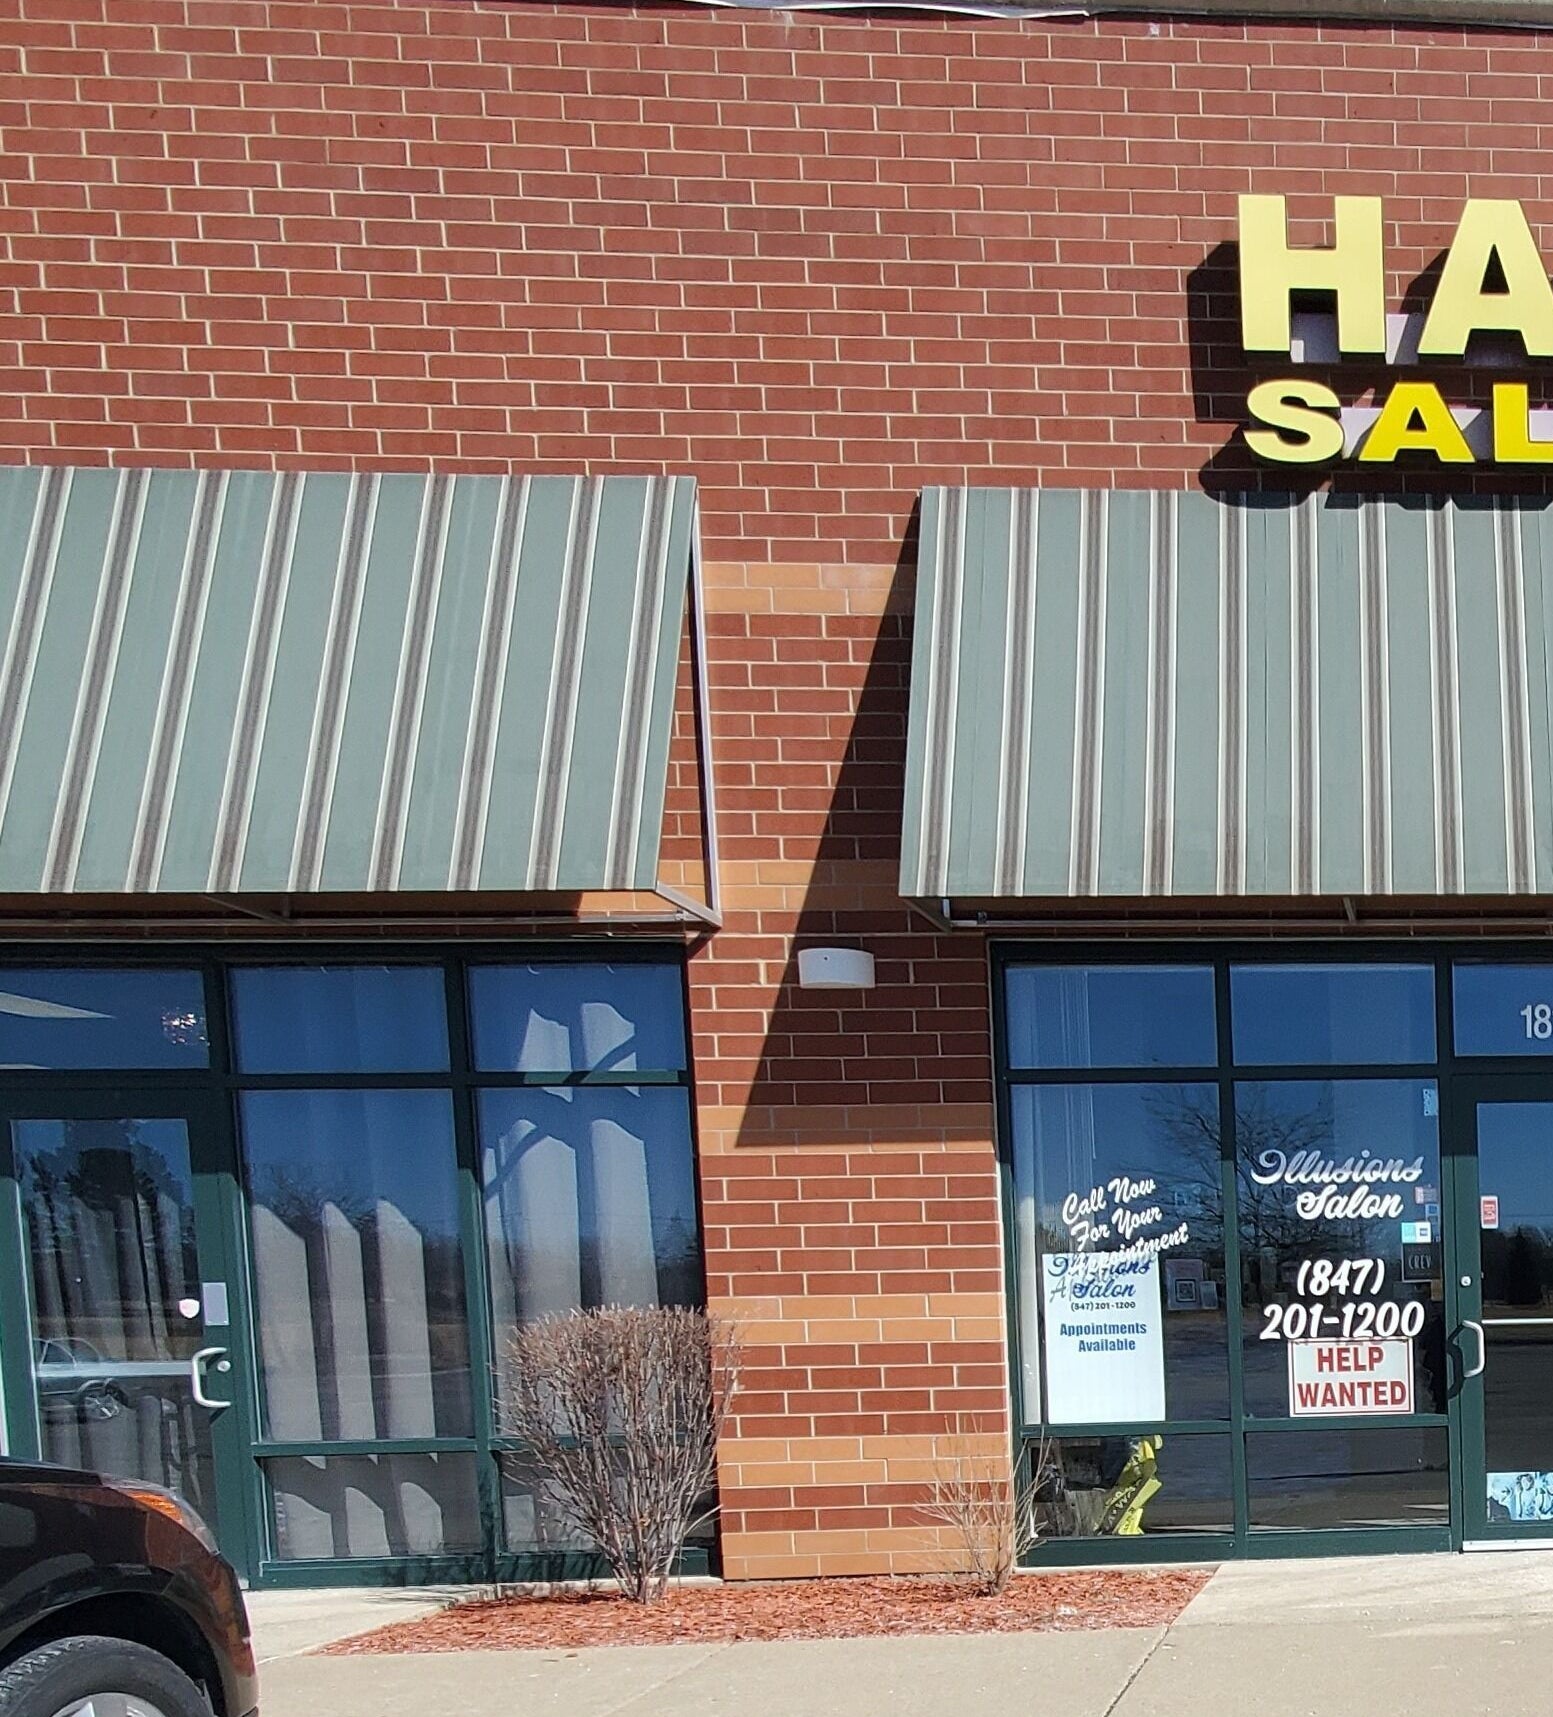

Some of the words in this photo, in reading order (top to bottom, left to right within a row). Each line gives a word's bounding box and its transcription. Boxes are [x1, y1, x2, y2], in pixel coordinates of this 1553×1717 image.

[1250, 1149, 1425, 1185] Illusions
[1062, 1186, 1107, 1225] Call
[1108, 1176, 1157, 1204] Now
[1296, 1185, 1404, 1220] Salon
[1071, 1221, 1111, 1252] For
[1111, 1206, 1163, 1240] Your
[1048, 1255, 1151, 1276] Iions
[1297, 1258, 1386, 1296] (847)
[1072, 1278, 1137, 1299] Salon
[1060, 1322, 1147, 1336] Appointments
[1259, 1301, 1426, 1340] 201-1200
[1078, 1338, 1136, 1352] Available
[1316, 1346, 1385, 1373] HELP
[1297, 1380, 1408, 1408] WANTED
